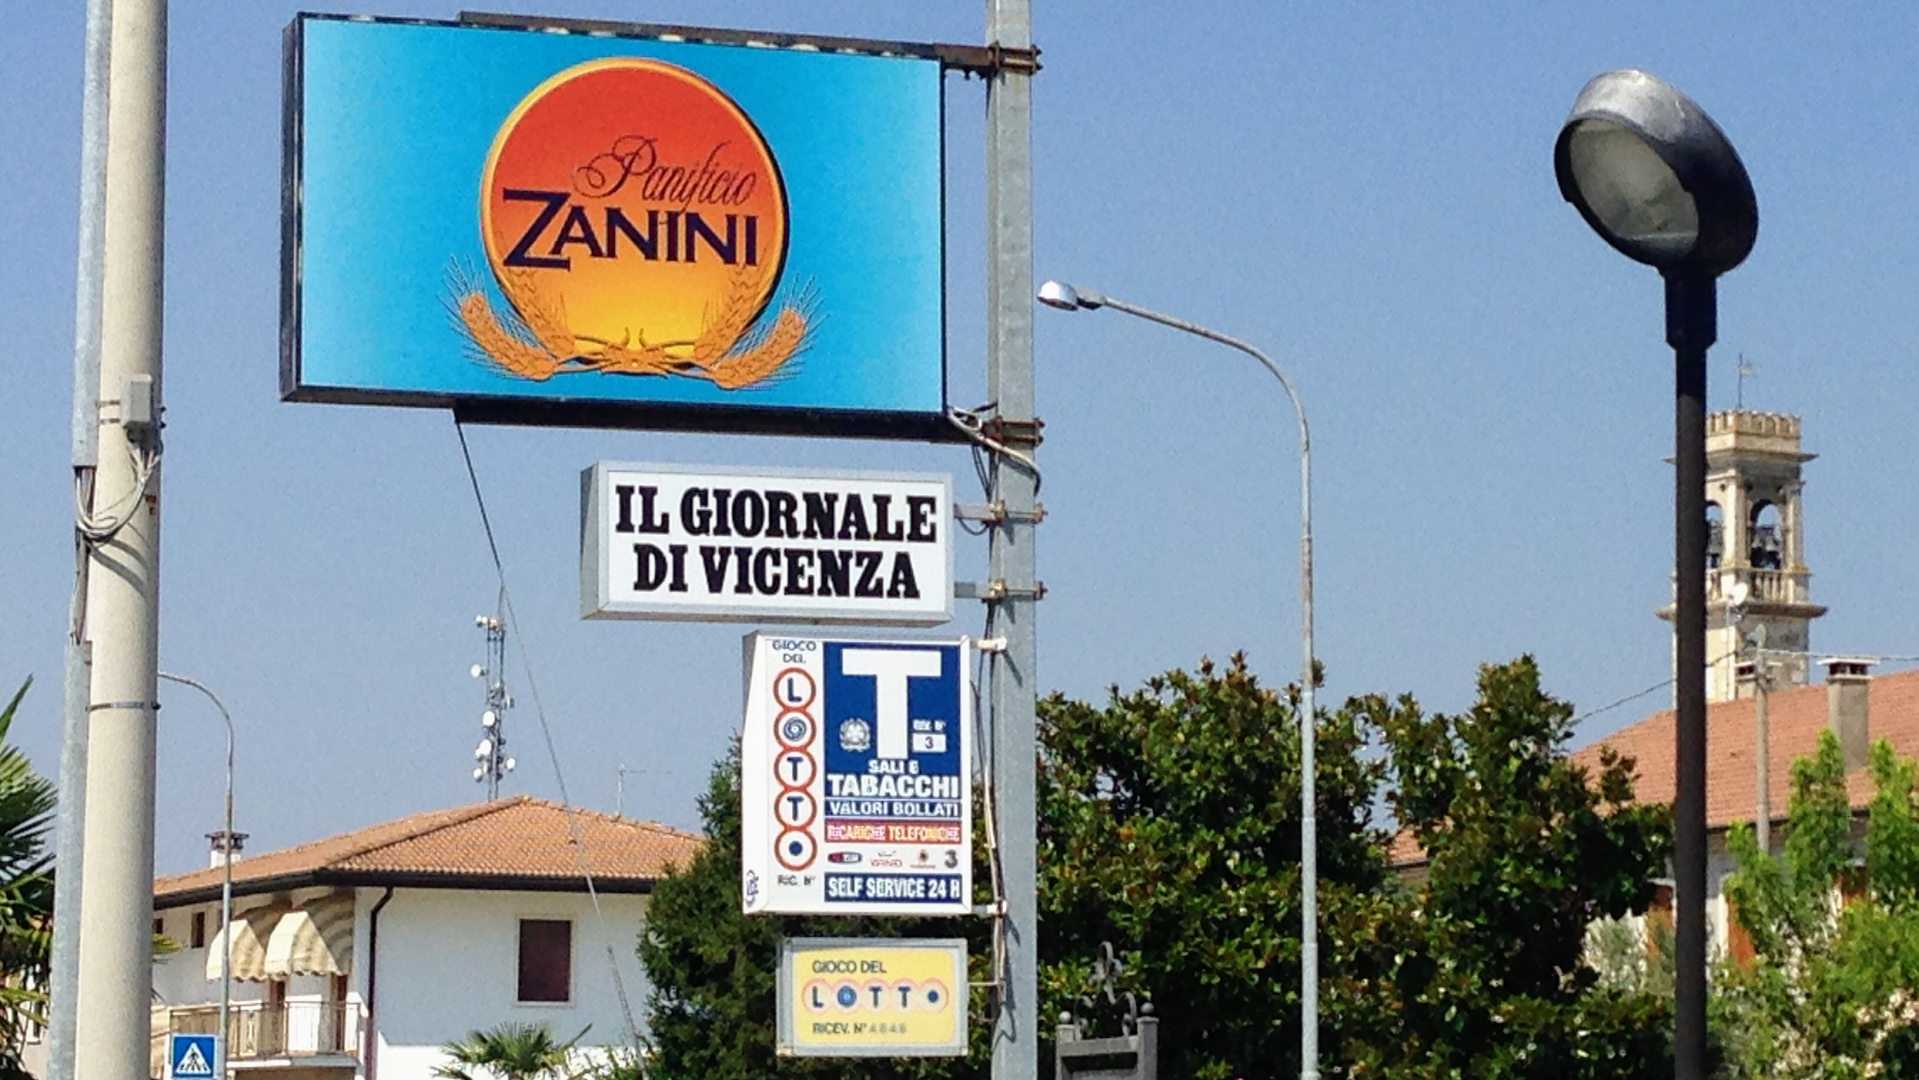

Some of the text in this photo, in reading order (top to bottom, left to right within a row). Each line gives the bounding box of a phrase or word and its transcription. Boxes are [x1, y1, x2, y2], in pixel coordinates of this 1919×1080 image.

[572, 134, 757, 220] Panificio
[502, 187, 759, 272] ZANINI
[615, 484, 937, 543] IL GIORNALE
[633, 543, 920, 598] DI VICENZA
[772, 640, 817, 651] GIOCO
[782, 653, 806, 664] DEL
[842, 648, 942, 759] T
[924, 736, 934, 749] 3
[868, 760, 905, 774] SALI
[827, 775, 959, 798] TABACCHI
[830, 801, 959, 816] VALORI BOLLATI
[827, 825, 960, 842] RICARICHE TELEFONICHE
[828, 877, 960, 898] SELF SERVICE 24 H
[812, 961, 887, 974] GIOCO DEL
